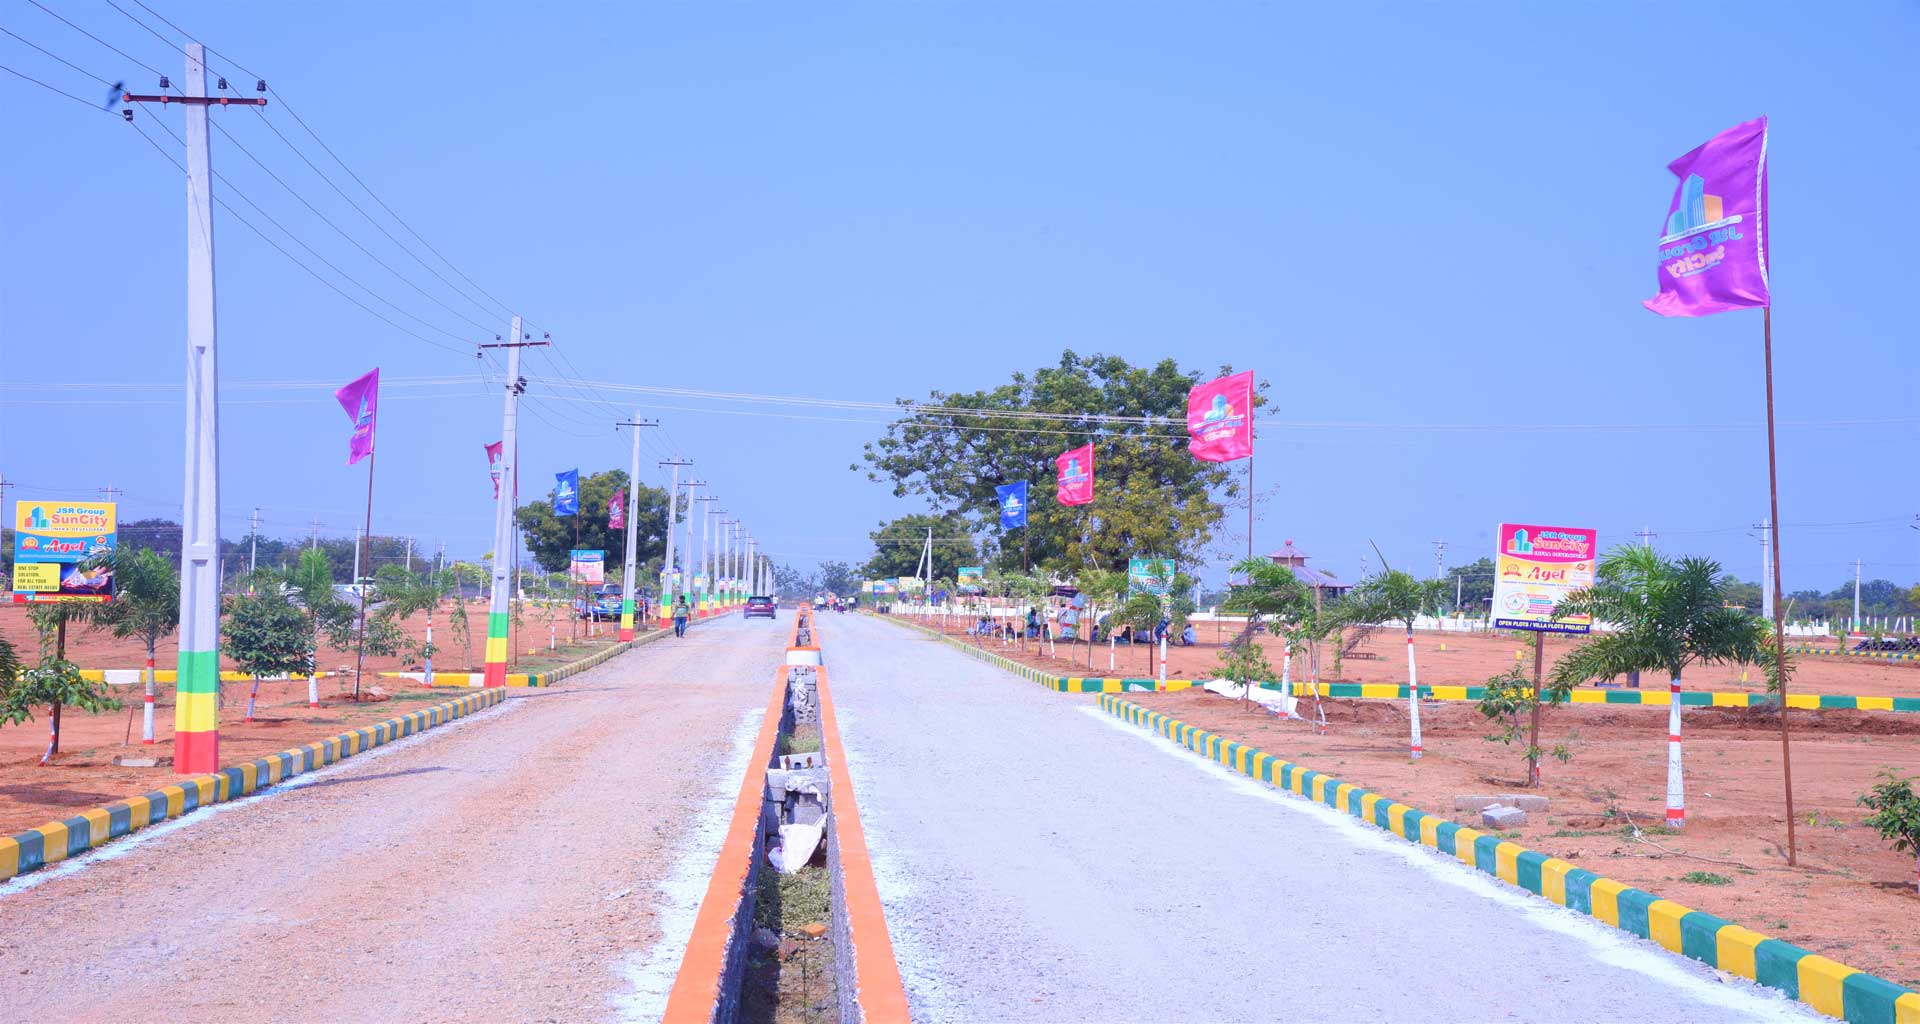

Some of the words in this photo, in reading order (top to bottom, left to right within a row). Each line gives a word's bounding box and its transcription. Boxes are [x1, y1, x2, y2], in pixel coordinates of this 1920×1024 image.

[77, 508, 105, 516] Group
[51, 514, 108, 527] SunCity
[1538, 531, 1557, 539] JSR
[1558, 533, 1587, 542] Group
[1533, 538, 1589, 555] SunCity
